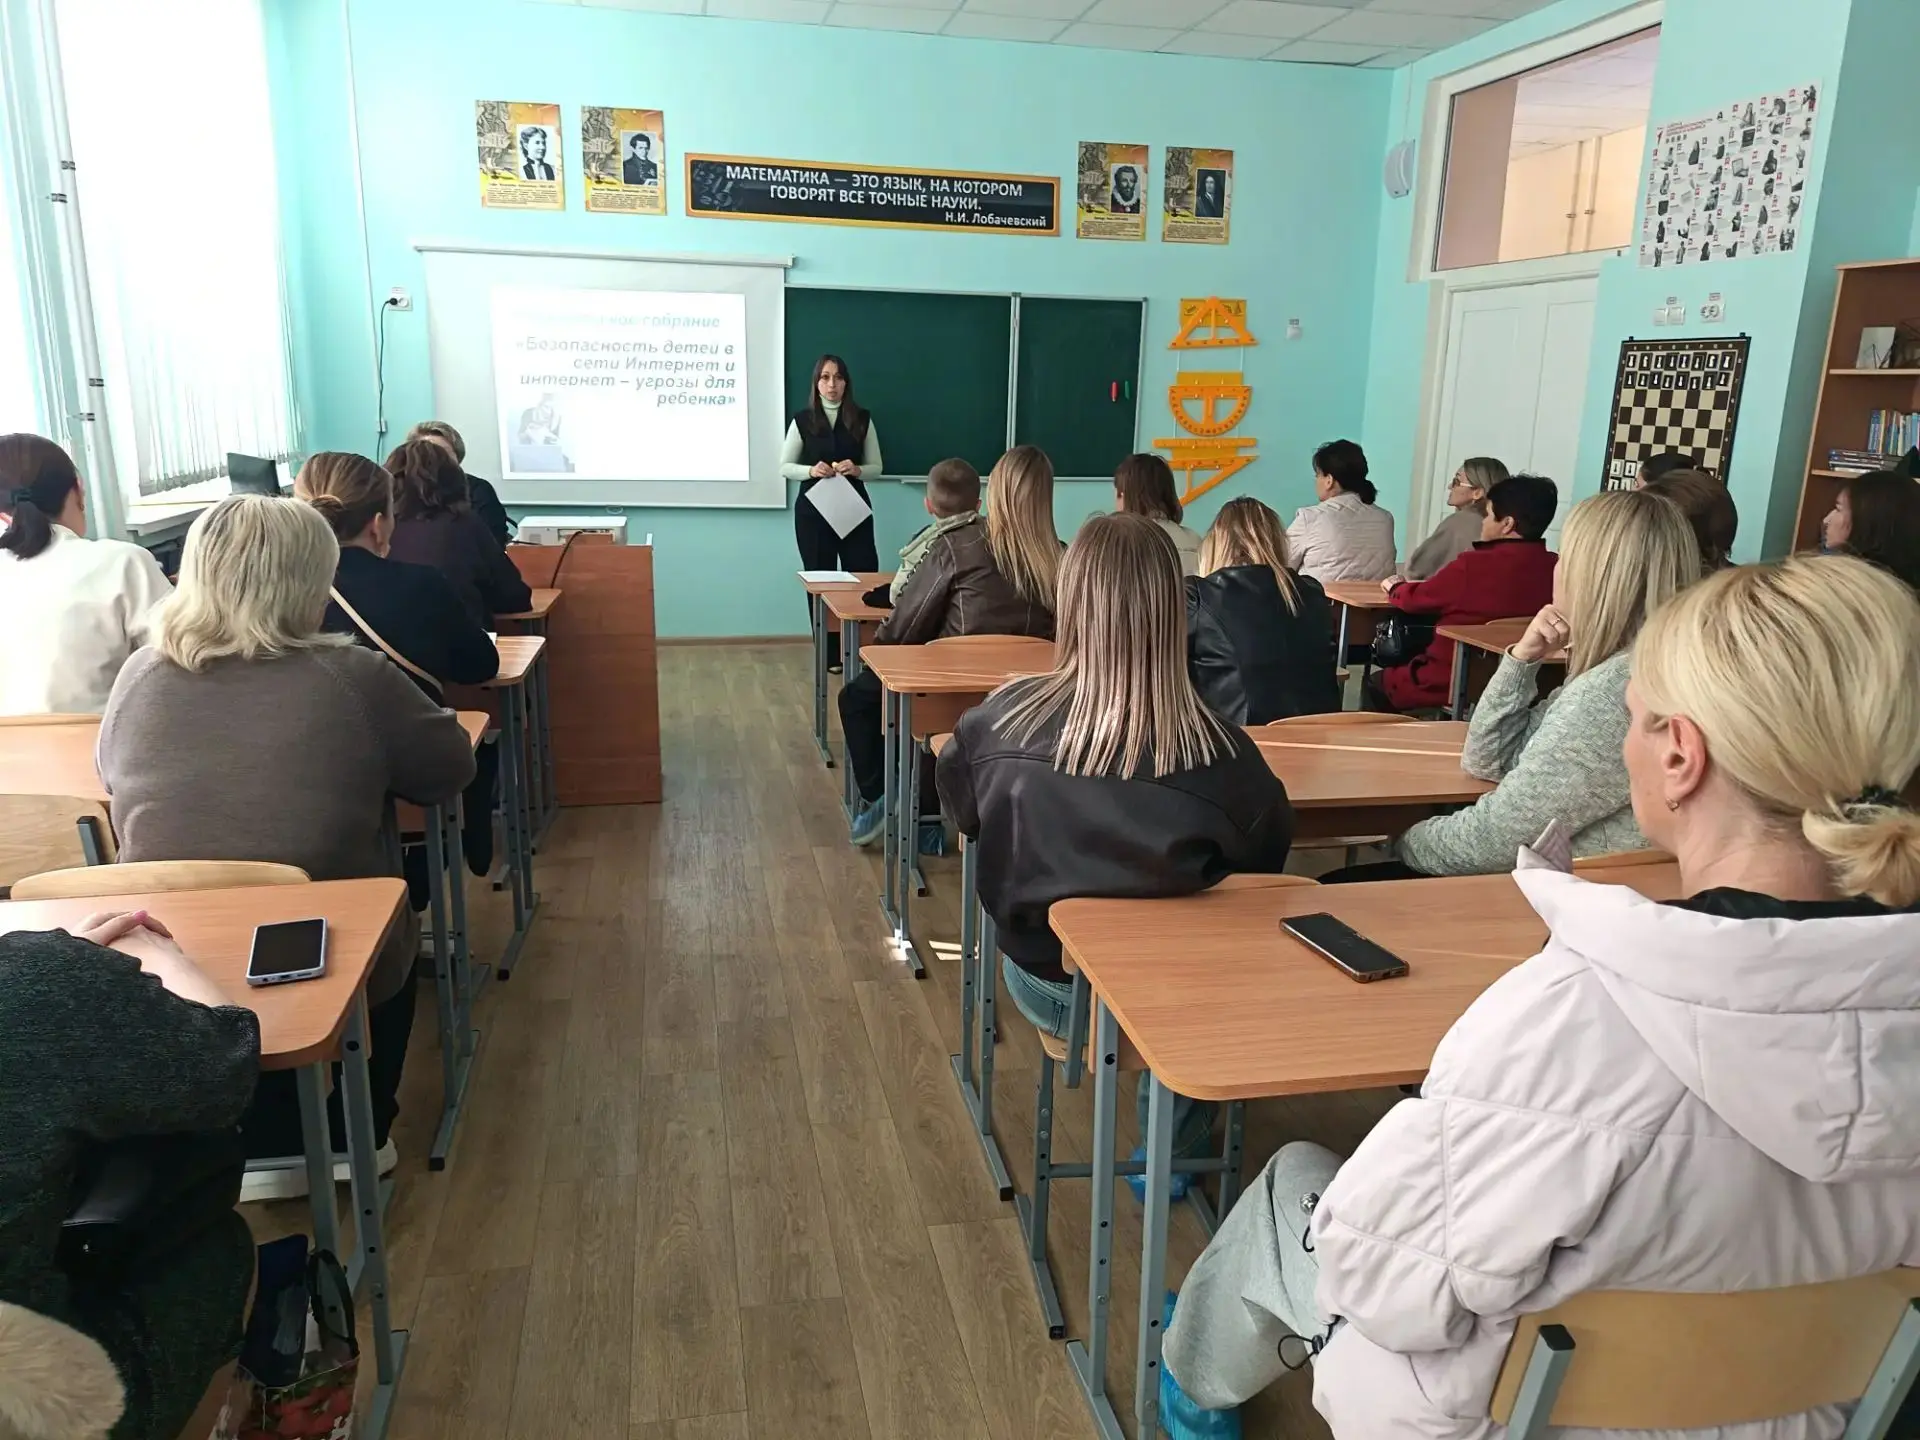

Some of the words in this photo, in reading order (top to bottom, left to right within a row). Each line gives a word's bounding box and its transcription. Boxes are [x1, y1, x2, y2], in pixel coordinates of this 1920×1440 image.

[726, 165, 830, 185] МАТЕМАТИКА
[852, 174, 879, 188] ЭТО
[883, 176, 926, 193] ЯЗЫК,
[930, 179, 950, 193] НА
[954, 180, 1023, 197] КОТОРОМ
[770, 185, 836, 202] ГОВОРЯТ
[840, 190, 865, 204] ВСЕ
[868, 191, 928, 208] ТОЧНЫЕ
[931, 196, 982, 211] НАУКИ.
[945, 212, 969, 223] Н.И.
[972, 213, 1047, 228] Лобачевский
[516, 335, 658, 355] «Безопасность
[663, 339, 719, 356] детей
[723, 343, 735, 354] в
[573, 357, 620, 370] сети
[625, 355, 720, 374] Интернет
[724, 361, 736, 372] и
[519, 374, 616, 388] интернет
[636, 376, 699, 391] угрозы
[704, 374, 736, 389] для
[656, 392, 736, 408] ребенка»
